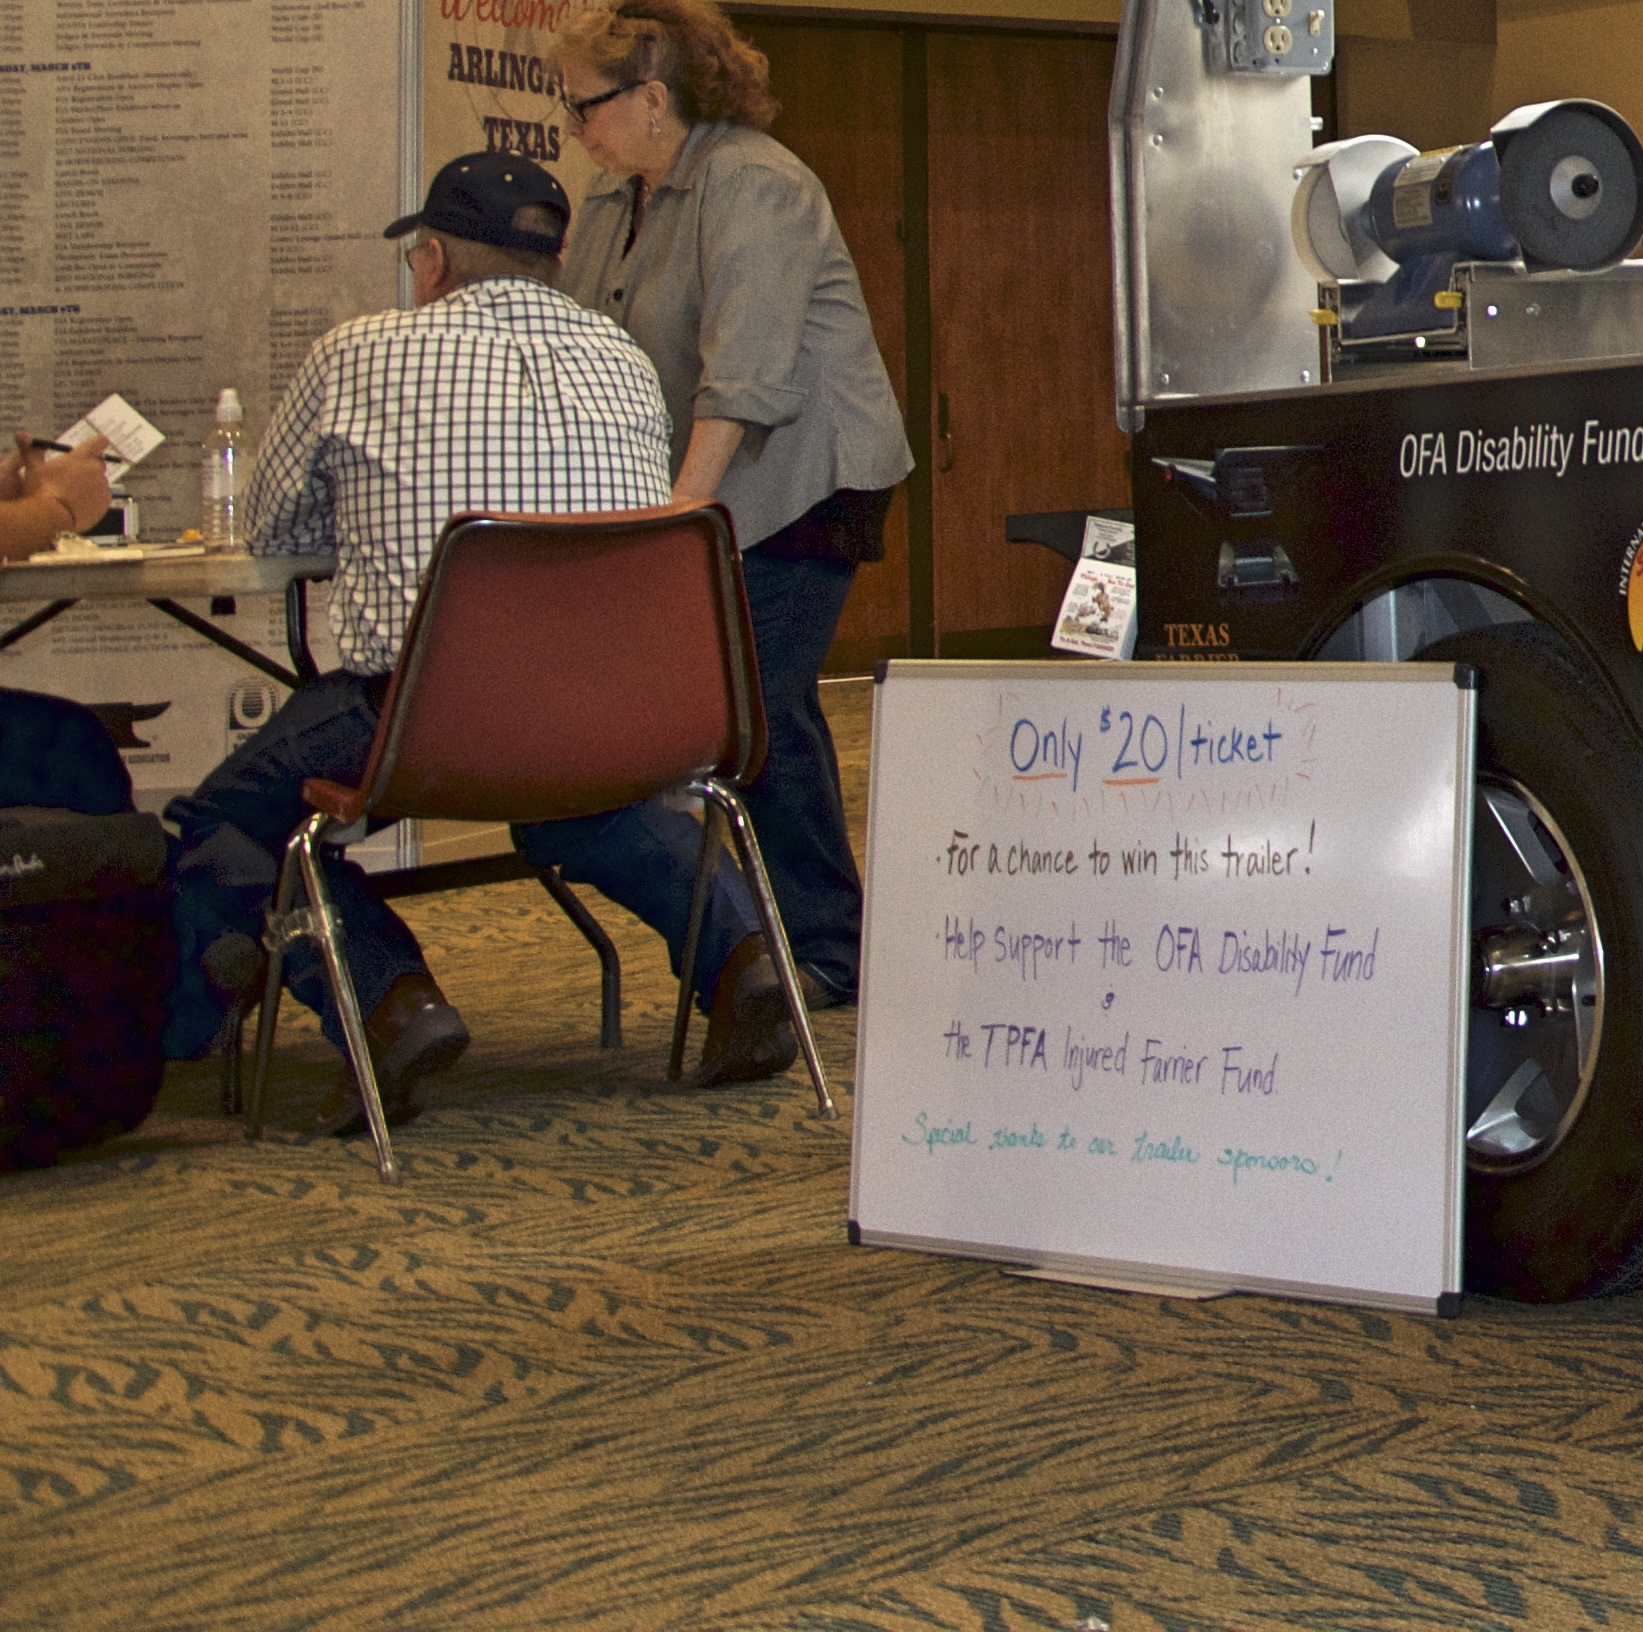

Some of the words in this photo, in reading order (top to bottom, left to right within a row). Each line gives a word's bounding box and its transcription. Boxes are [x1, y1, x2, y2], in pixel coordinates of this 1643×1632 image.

[483, 115, 561, 162] TEXAS
[1400, 432, 1447, 479] OFA
[1456, 423, 1575, 478] Disability
[1163, 622, 1230, 647] TEXAS
[1009, 717, 1083, 793] Only
[946, 828, 980, 876] For
[988, 848, 1002, 873] a
[1007, 838, 1079, 875] chance
[1088, 837, 1111, 873] to
[1121, 839, 1158, 876] win
[1170, 831, 1210, 881] this
[943, 914, 986, 972] Help
[993, 920, 1082, 981] Support
[1098, 919, 1133, 968] the
[1155, 923, 1203, 973] OFA
[1218, 930, 1312, 997] Disability
[1320, 923, 1380, 982] Fund
[943, 1019, 972, 1062] the
[980, 1023, 1049, 1072] TPFA
[1064, 1025, 1129, 1093] Injured
[1140, 1038, 1209, 1086] Farrier
[902, 1110, 978, 1157] Special
[988, 1122, 1046, 1151] thanks
[1057, 1125, 1078, 1151] to
[1087, 1136, 1119, 1157] our
[1130, 1130, 1200, 1164] trailer
